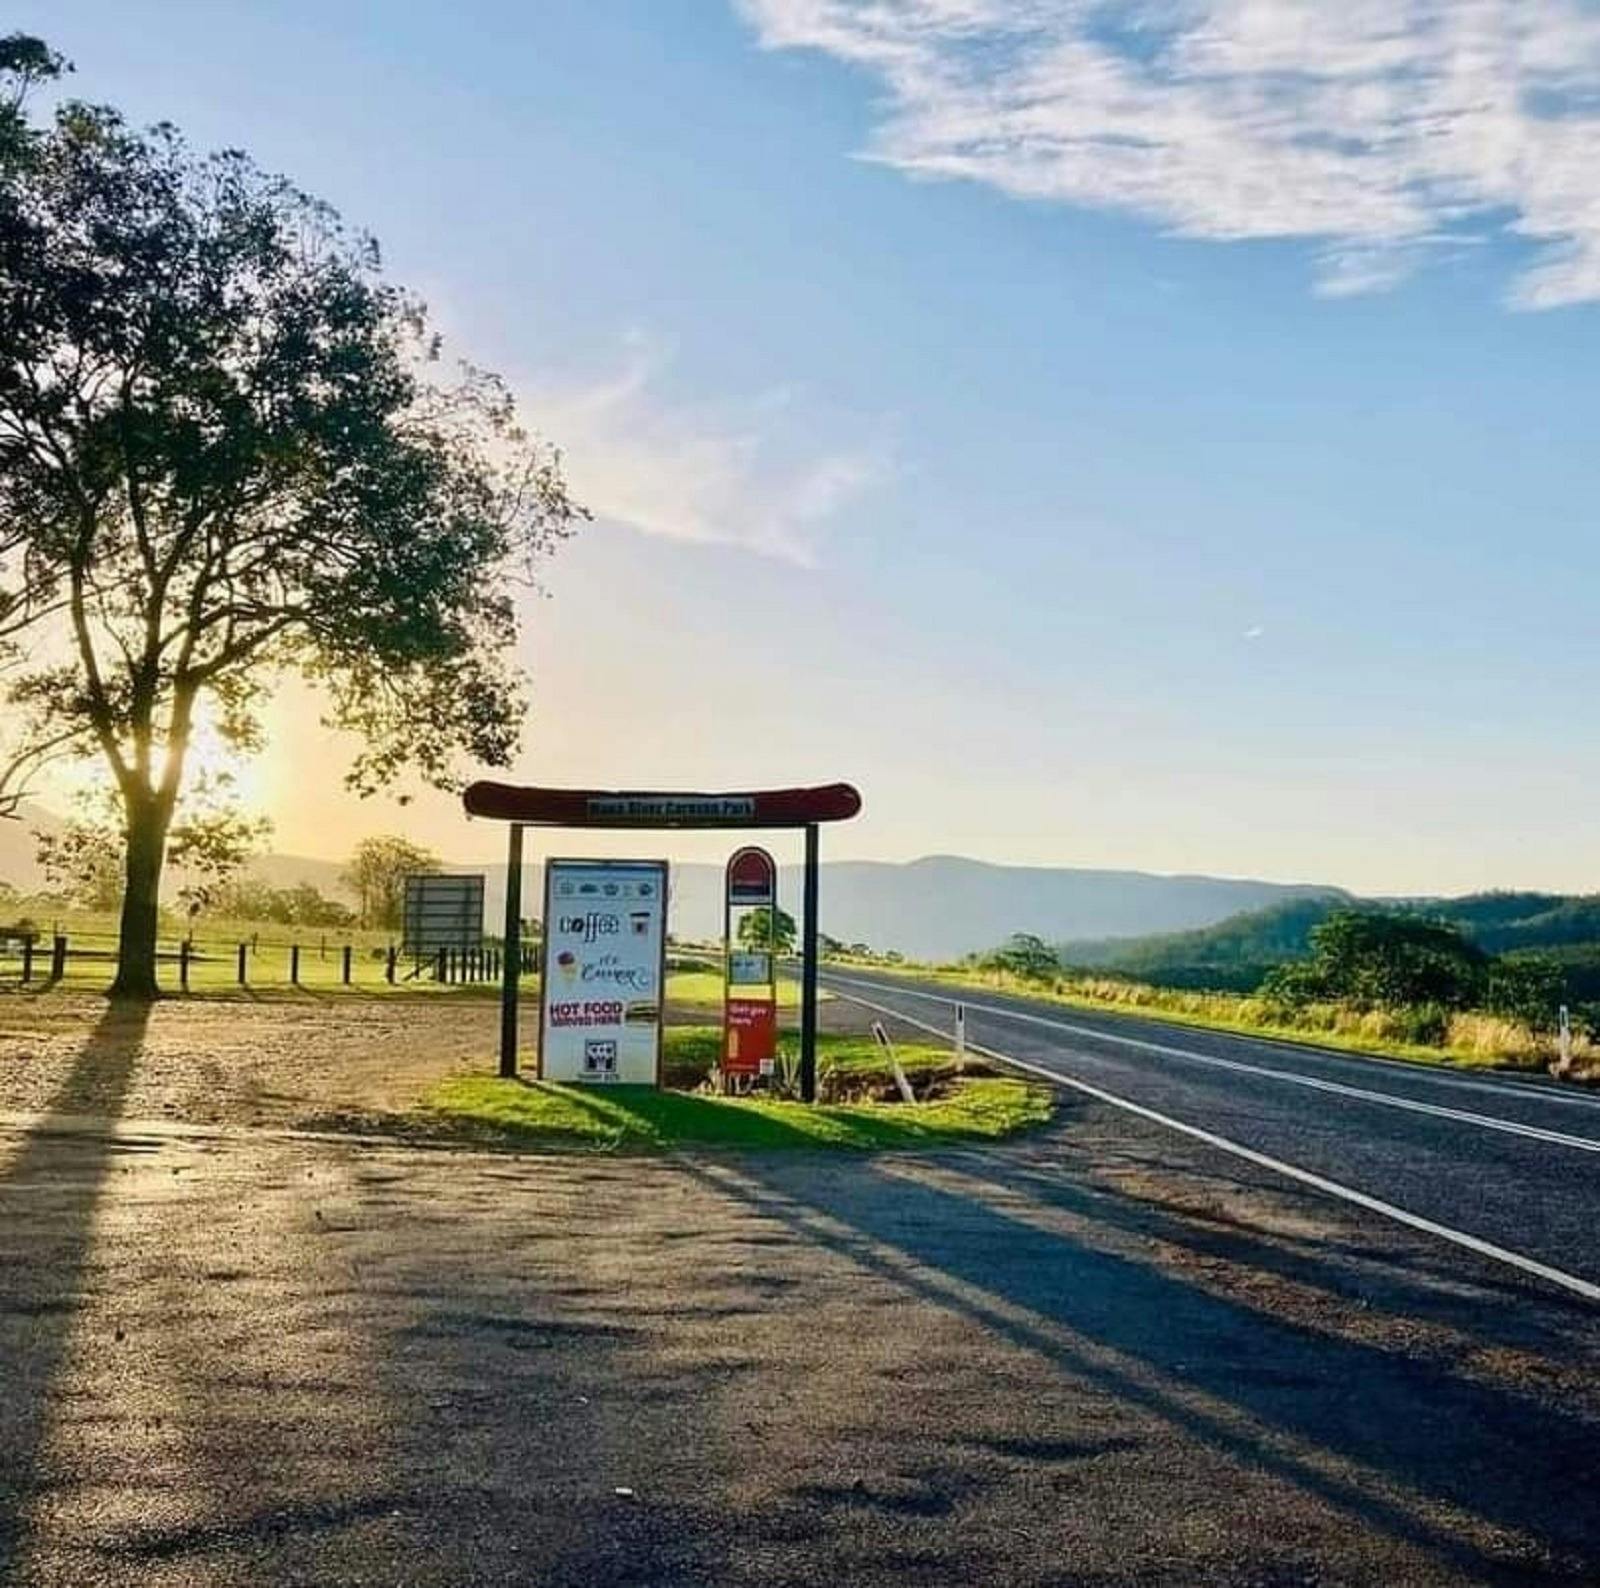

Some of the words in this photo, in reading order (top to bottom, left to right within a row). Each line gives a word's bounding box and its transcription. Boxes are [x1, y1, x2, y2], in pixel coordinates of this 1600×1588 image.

[629, 801, 663, 815] River
[665, 801, 720, 815] Caravan
[723, 801, 753, 815] Park
[551, 1002, 580, 1017] HOT
[584, 1000, 623, 1014] FOOD
